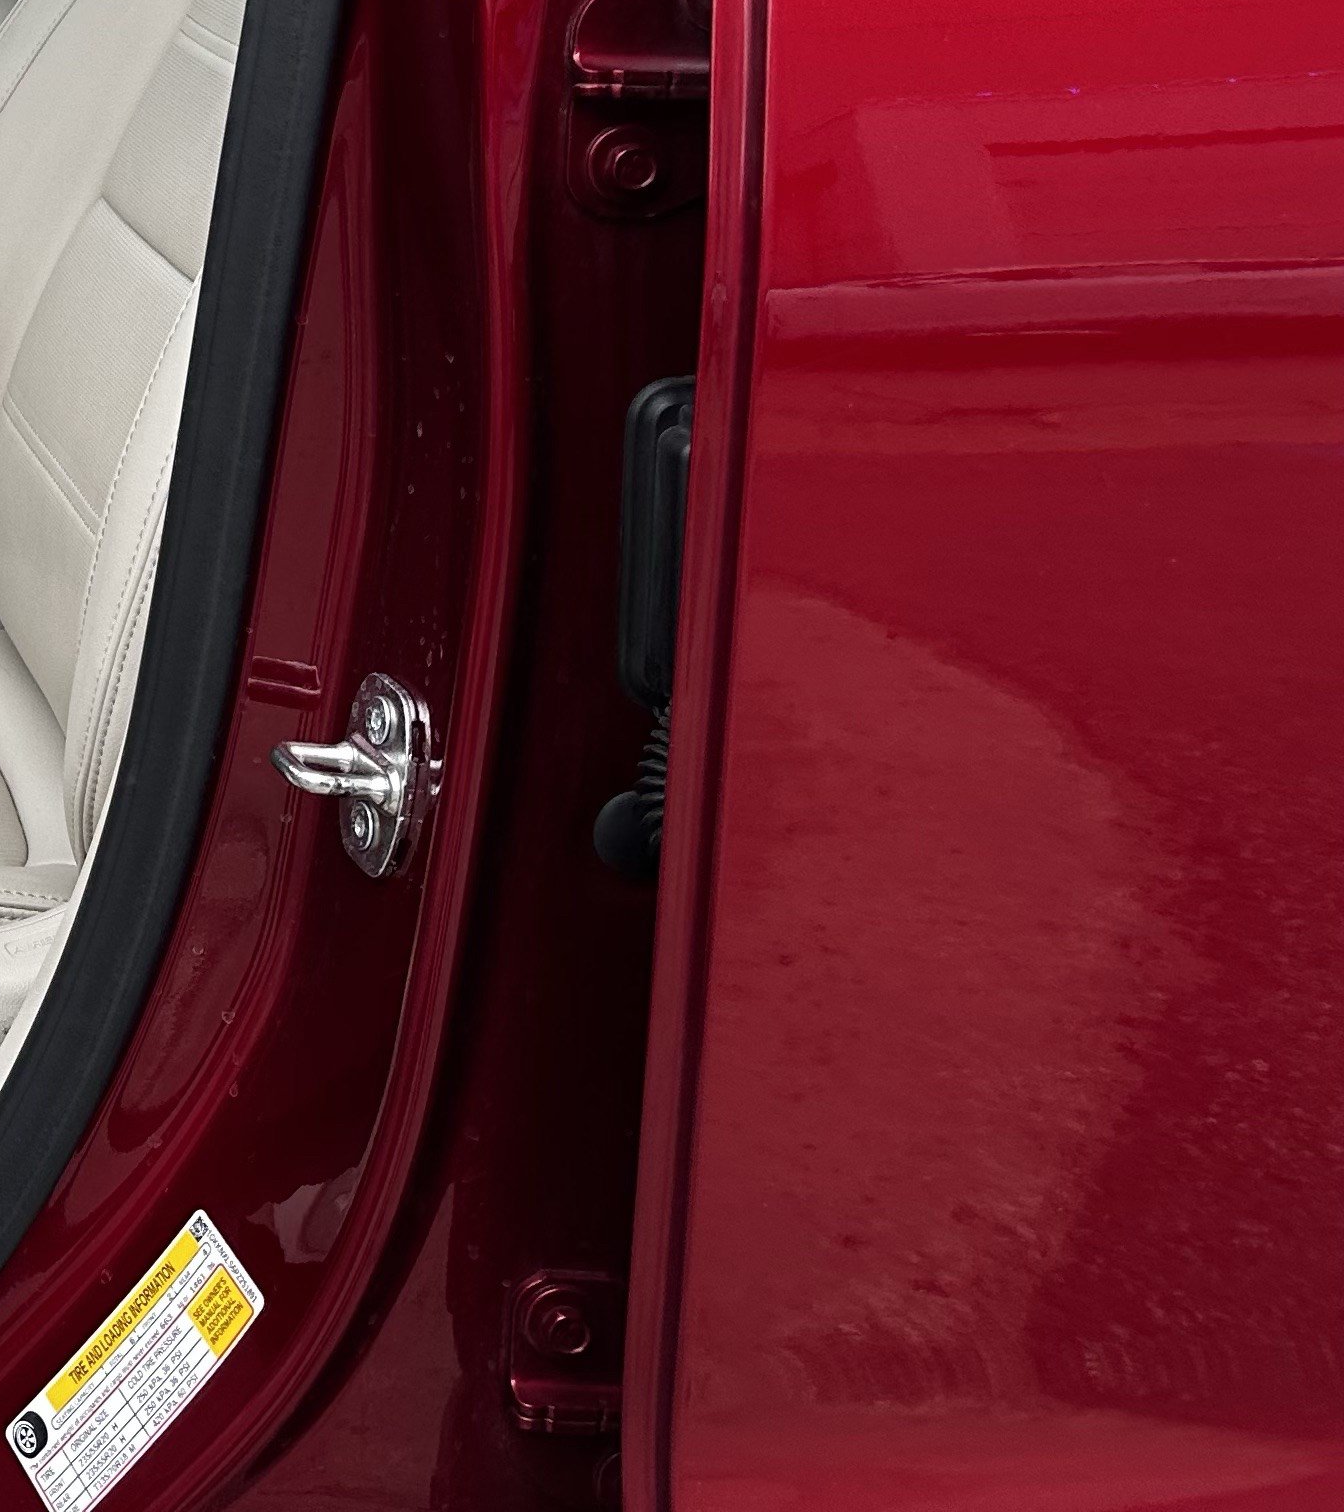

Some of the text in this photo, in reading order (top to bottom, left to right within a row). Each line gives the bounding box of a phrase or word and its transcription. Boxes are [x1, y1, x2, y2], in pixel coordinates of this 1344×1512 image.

[68, 1262, 175, 1384] TIRE AND LOADING INFORMATION
